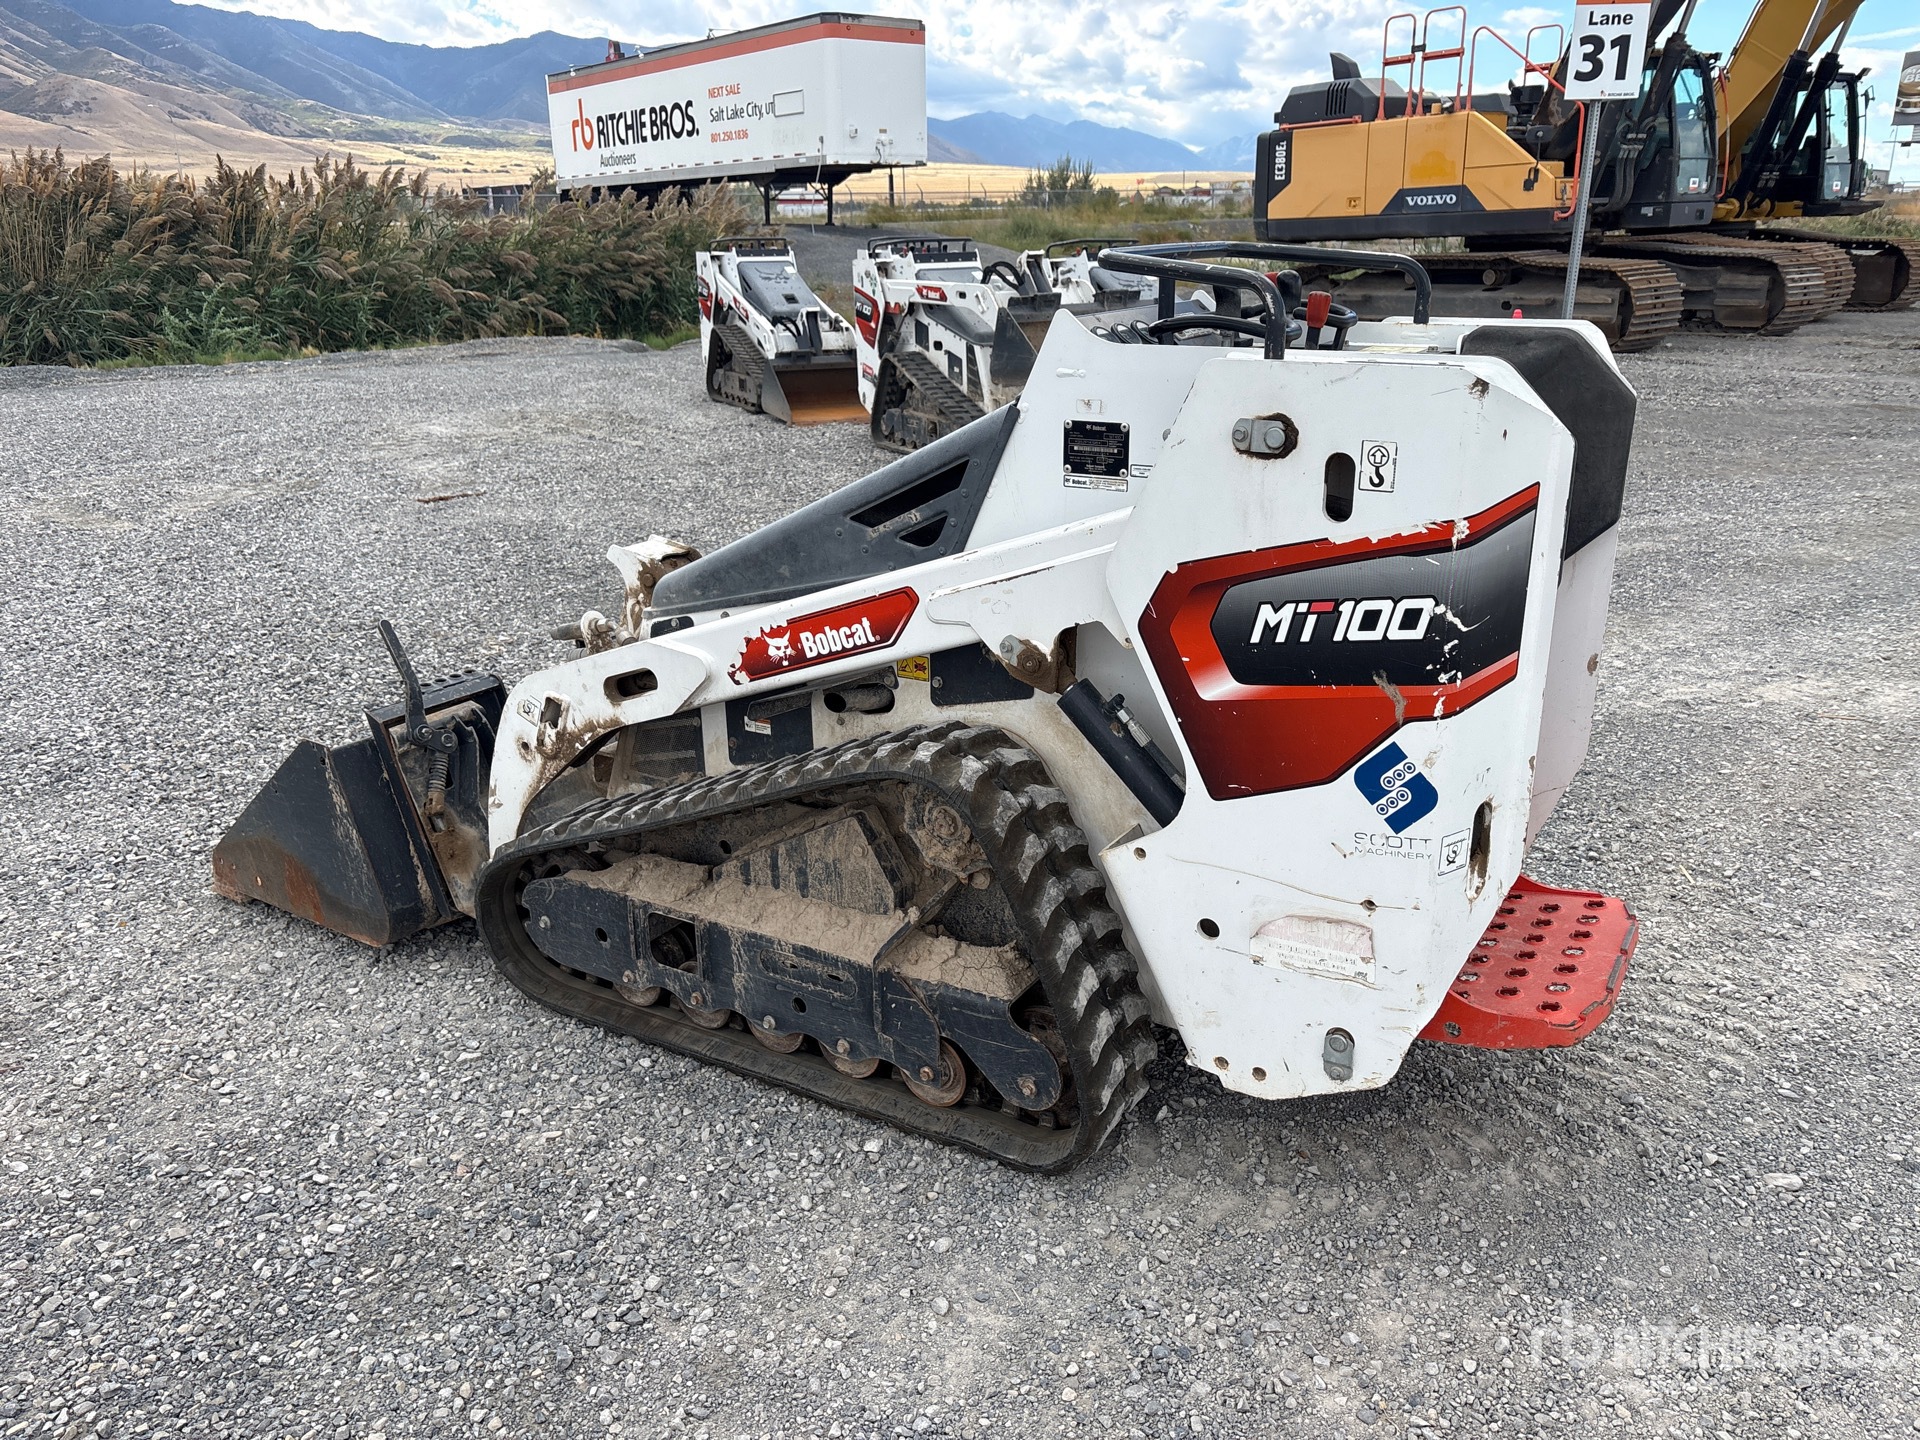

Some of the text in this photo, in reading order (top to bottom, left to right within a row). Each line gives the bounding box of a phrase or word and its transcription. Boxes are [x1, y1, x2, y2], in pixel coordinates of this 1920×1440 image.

[1588, 11, 1633, 26] Lane
[1573, 34, 1632, 82] 31
[708, 83, 741, 99] NEXT SALE
[709, 106, 725, 123] Salt
[726, 103, 745, 121] Lake
[746, 101, 764, 121] City,
[597, 108, 648, 149] RITCHIE
[649, 99, 700, 142] BROS.
[710, 129, 749, 143] 801.250.1836
[600, 152, 637, 168] Auctioneers
[1405, 193, 1457, 206] VOLVO
[1249, 597, 1437, 644] MT100
[1354, 832, 1433, 850] SCOTT
[1354, 846, 1433, 860] MACHINERY
